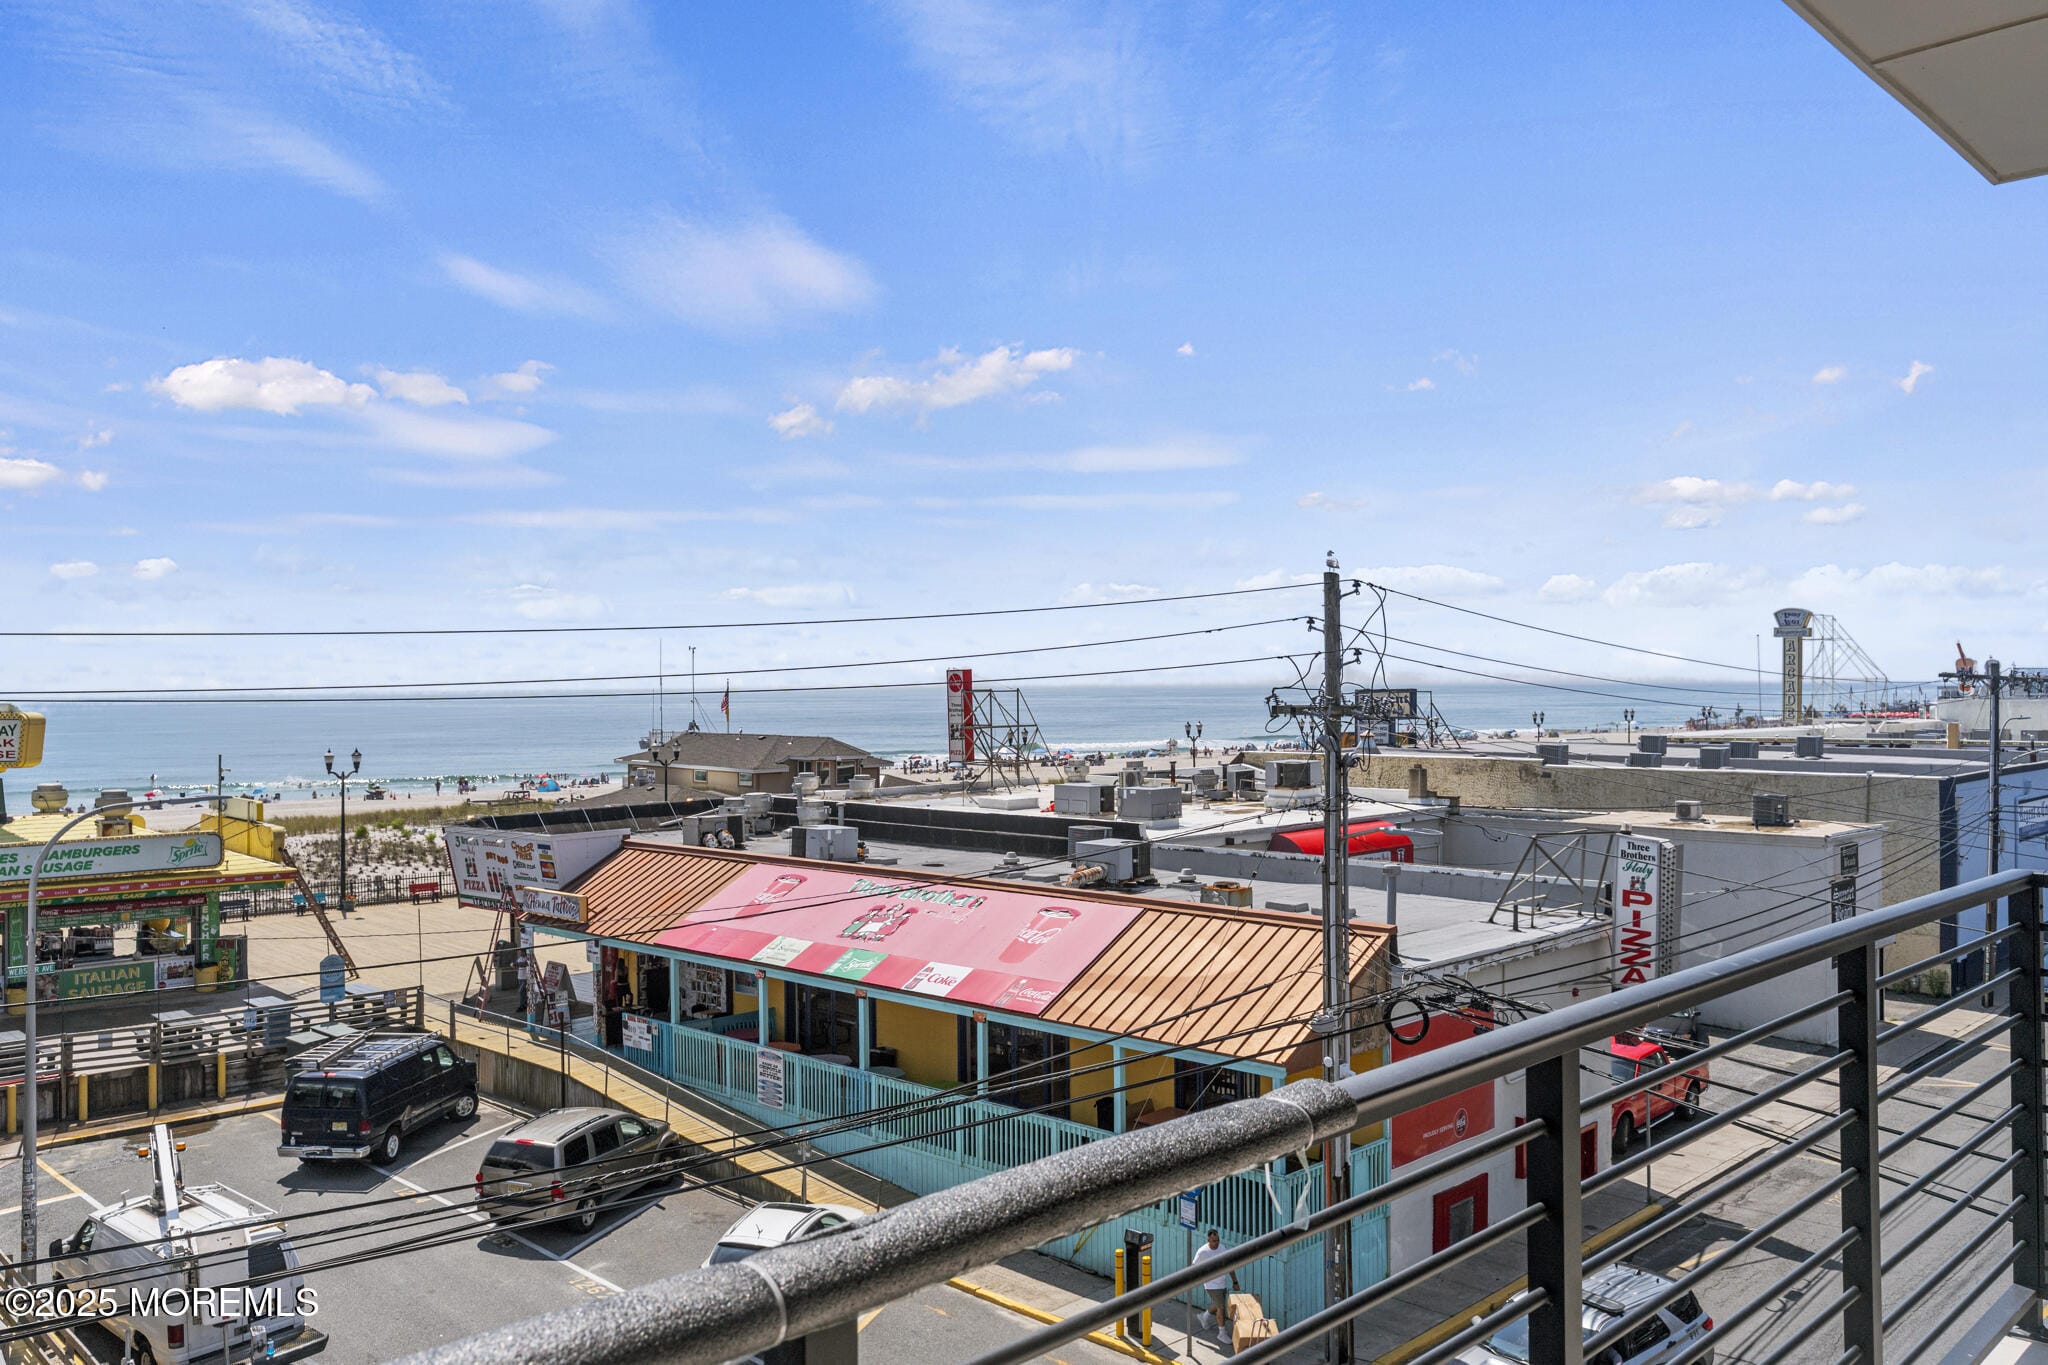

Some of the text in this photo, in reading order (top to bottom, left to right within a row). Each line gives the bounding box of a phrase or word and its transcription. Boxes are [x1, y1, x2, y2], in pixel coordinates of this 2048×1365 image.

[1786, 640, 1796, 719] ARCADE
[0, 739, 15, 747] K
[46, 845, 141, 860] AMBURGERS
[171, 843, 204, 862] Sprite
[1626, 841, 1650, 852] Three
[1620, 849, 1656, 862] Brothers
[23, 861, 94, 874] SUSAGE
[1622, 861, 1654, 879] Italy
[464, 879, 487, 892] PIZZA
[525, 892, 550, 911] Henna
[1620, 889, 1653, 985] PIZZA
[9, 964, 54, 976] WEBSR AVE
[74, 967, 140, 985] ITALIAN
[927, 974, 957, 986] Coke
[67, 980, 146, 997] SAUSAGE
